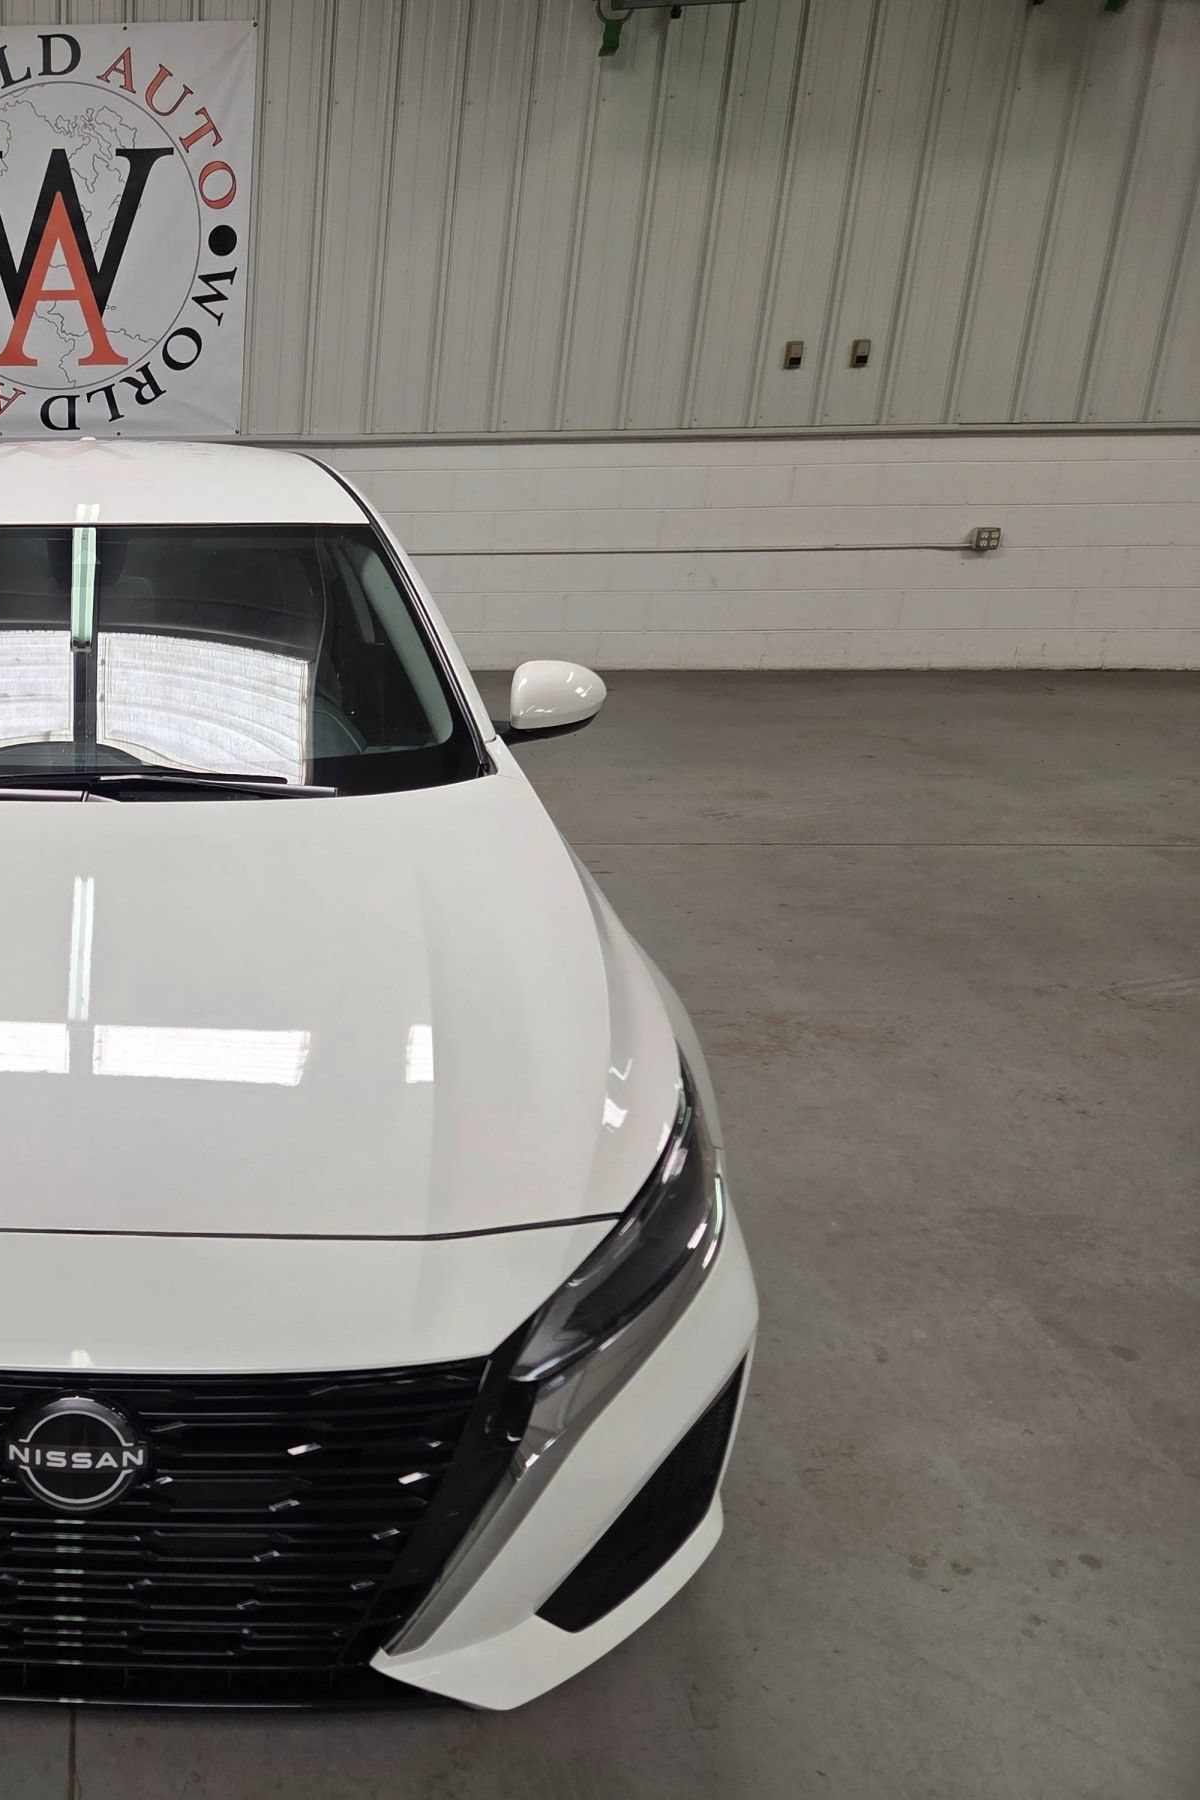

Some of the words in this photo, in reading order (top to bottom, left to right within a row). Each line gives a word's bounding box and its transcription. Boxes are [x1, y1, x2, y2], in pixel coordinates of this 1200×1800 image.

[96, 46, 237, 210] AUTO
[39, 266, 238, 431] WORLD
[8, 1444, 144, 1469] NISSAN
